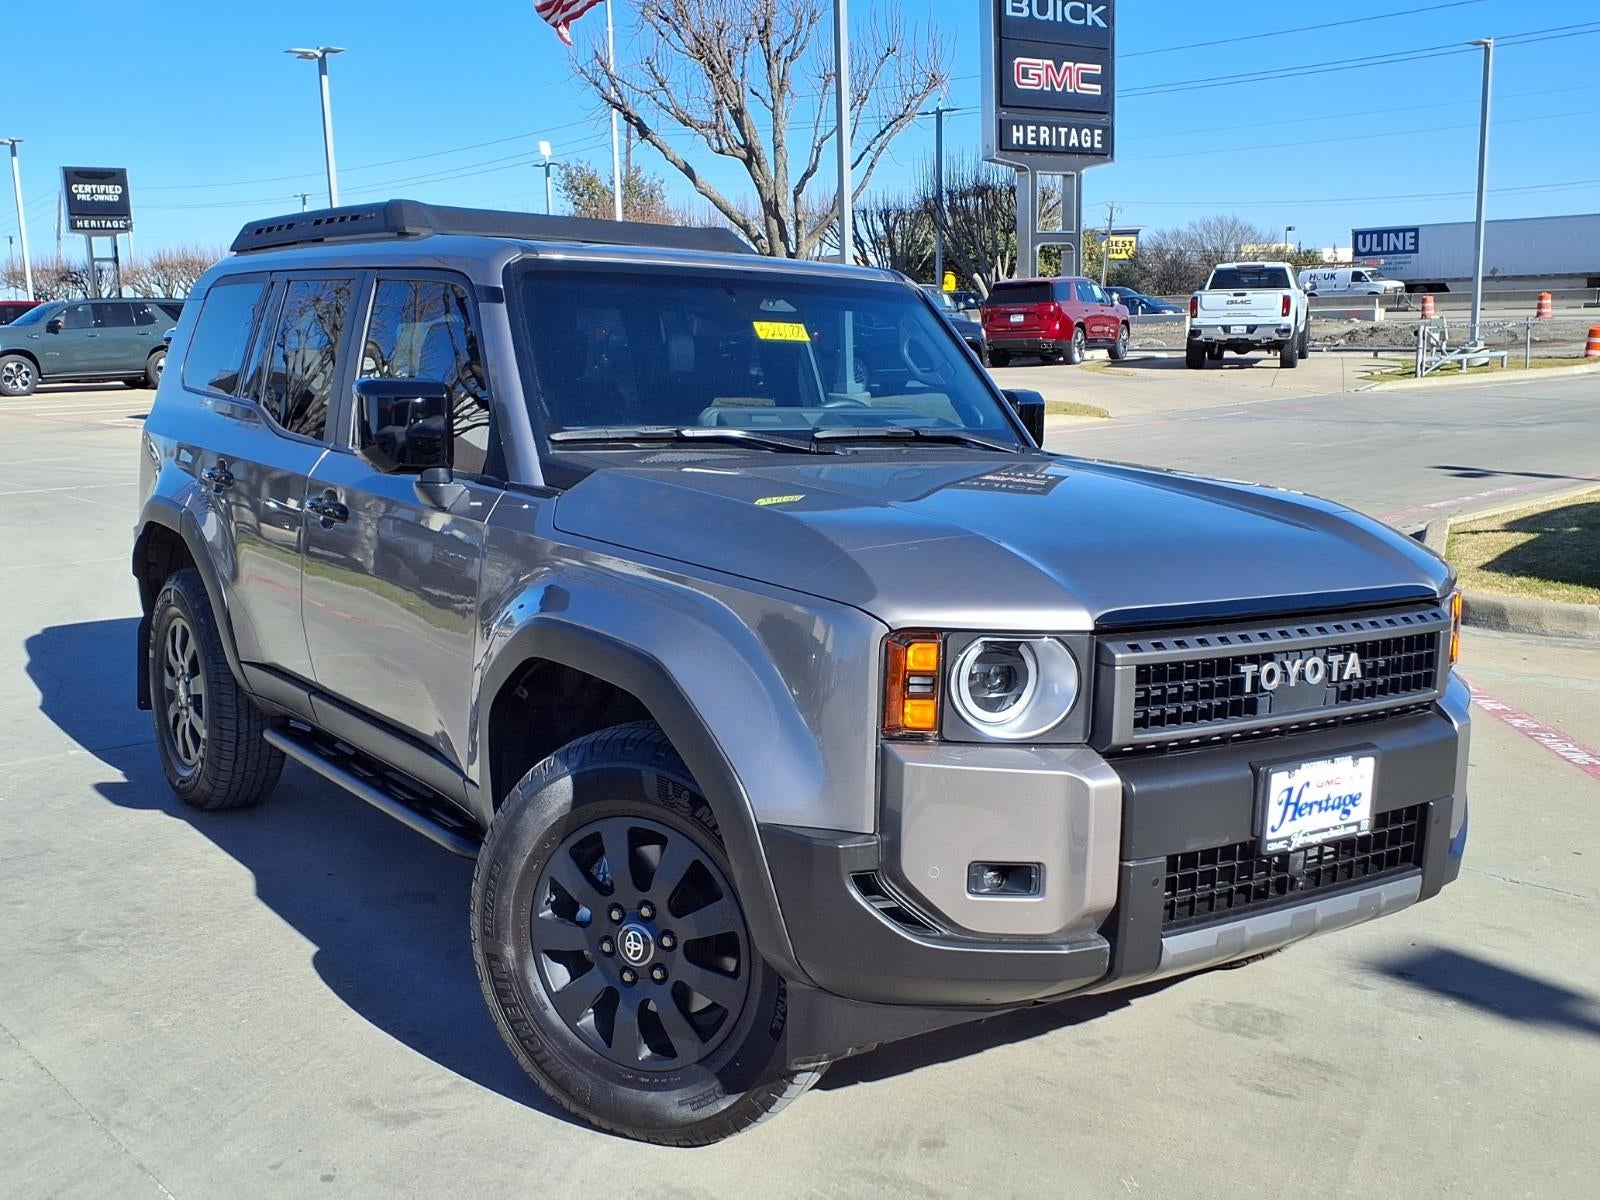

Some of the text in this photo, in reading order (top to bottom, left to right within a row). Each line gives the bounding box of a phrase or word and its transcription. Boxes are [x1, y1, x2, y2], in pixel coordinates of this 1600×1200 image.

[1006, 0, 1108, 28] BUICK
[1013, 57, 1102, 95] GMC
[1012, 125, 1103, 148] HERITAGE
[72, 184, 122, 194] CERTIFIED
[77, 194, 119, 202] PRE-OWNED
[77, 220, 125, 228] HERITAGE
[1357, 231, 1416, 253] ULINE
[1309, 272, 1337, 281] HOUK
[1240, 652, 1363, 693] TOYOTA
[1270, 781, 1363, 833] Heritage
